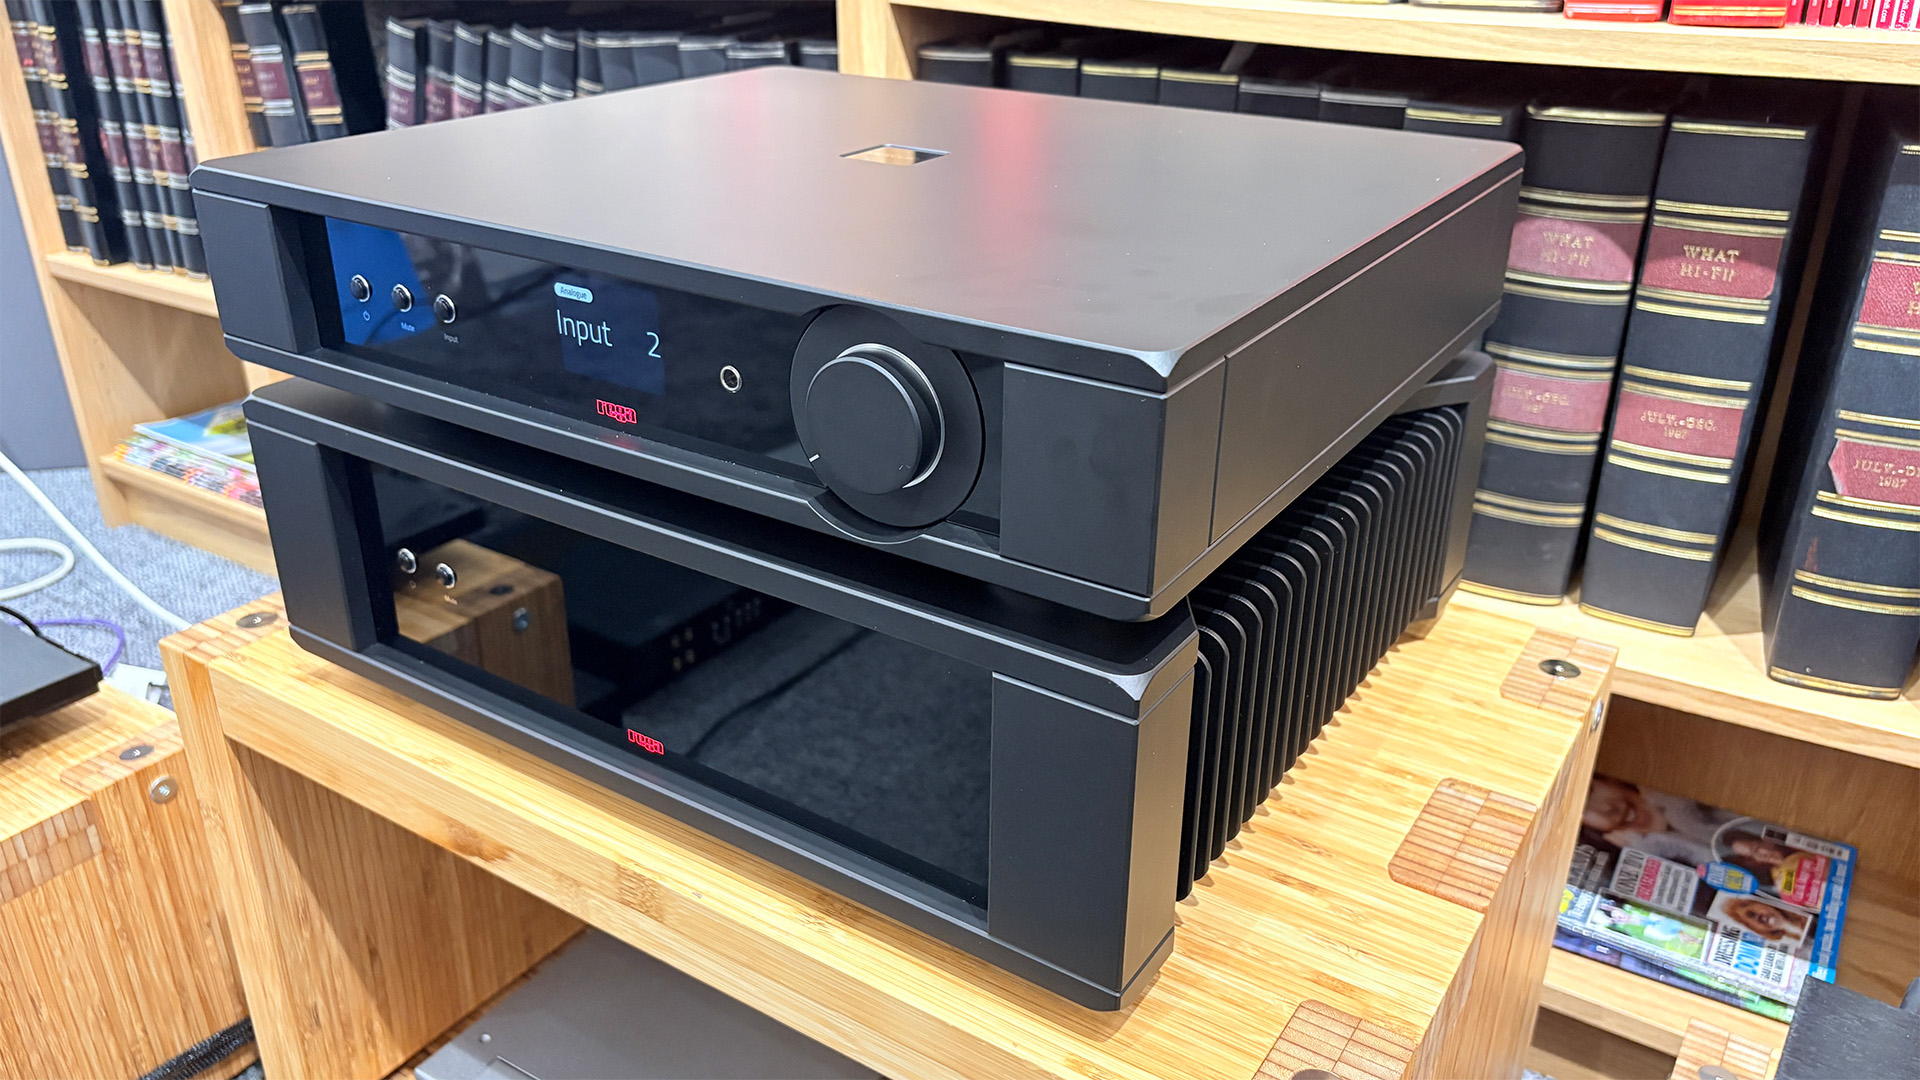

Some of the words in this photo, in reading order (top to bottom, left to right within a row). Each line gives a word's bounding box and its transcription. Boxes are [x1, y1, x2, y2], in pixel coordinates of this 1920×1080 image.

[1683, 244, 1740, 264] WHAT
[560, 286, 588, 300] Analogue
[556, 308, 614, 347] Input
[646, 331, 662, 359] 2
[595, 398, 638, 425] rega
[627, 728, 665, 756] rega
